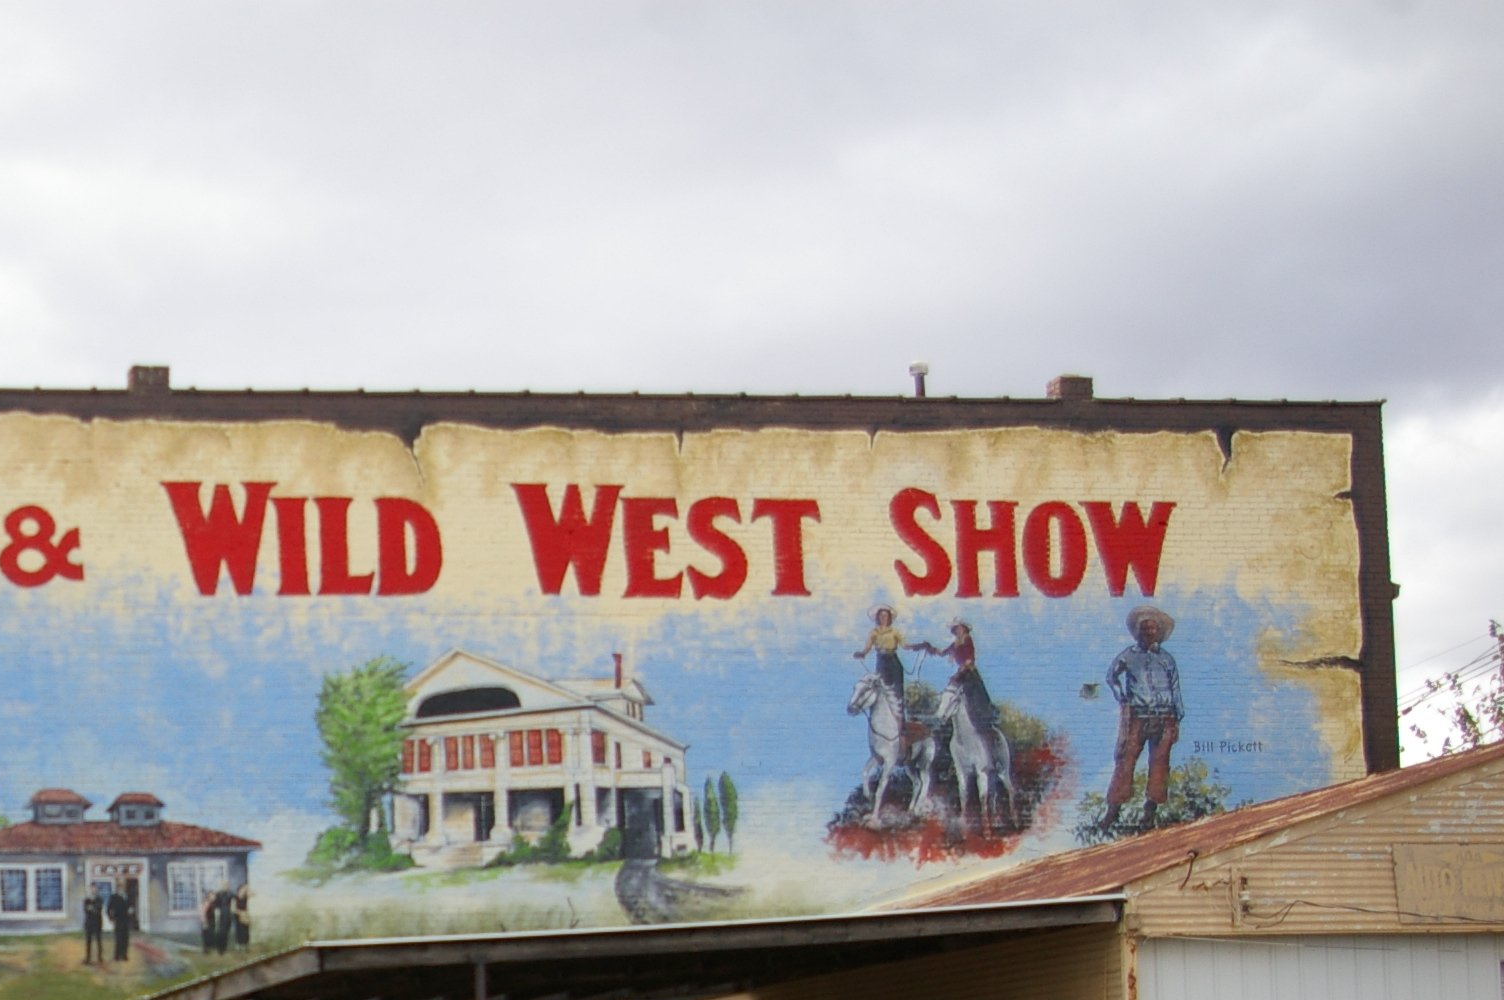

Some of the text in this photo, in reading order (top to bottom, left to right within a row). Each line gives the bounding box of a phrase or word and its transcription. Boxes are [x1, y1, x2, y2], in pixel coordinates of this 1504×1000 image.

[161, 480, 444, 597] WILD
[510, 483, 822, 600] WEST
[889, 487, 1177, 598] SHOW
[1193, 740, 1265, 753] Bill Pickett
